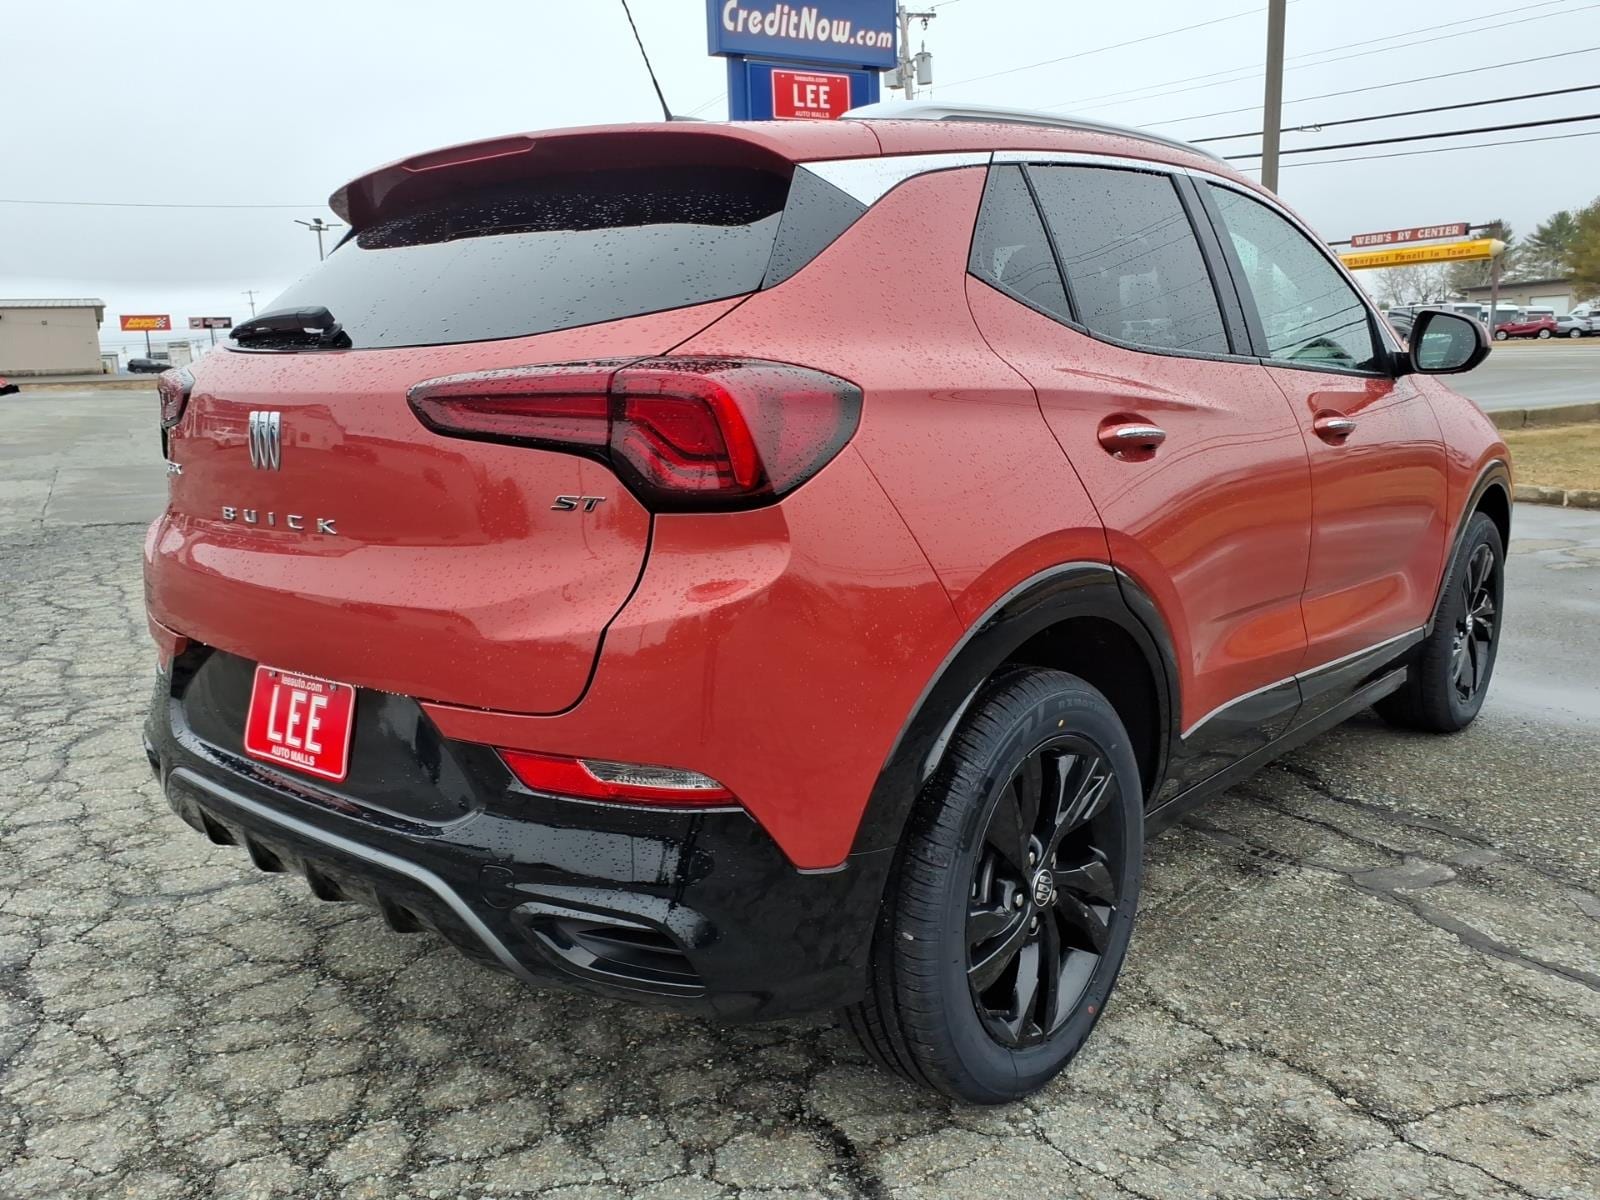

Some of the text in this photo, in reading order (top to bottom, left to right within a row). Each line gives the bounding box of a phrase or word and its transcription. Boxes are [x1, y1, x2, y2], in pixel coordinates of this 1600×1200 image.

[722, 0, 893, 48] CreditNow.com
[793, 83, 831, 109] LEE
[795, 110, 830, 119] AUTO MALLS
[1355, 225, 1459, 246] WEBB'S RV CENTER
[550, 495, 607, 513] ST
[221, 505, 338, 535] BUICK
[281, 674, 323, 693] leeauto.com
[267, 684, 329, 754] LEE
[271, 745, 316, 767] AUTO MALLS
